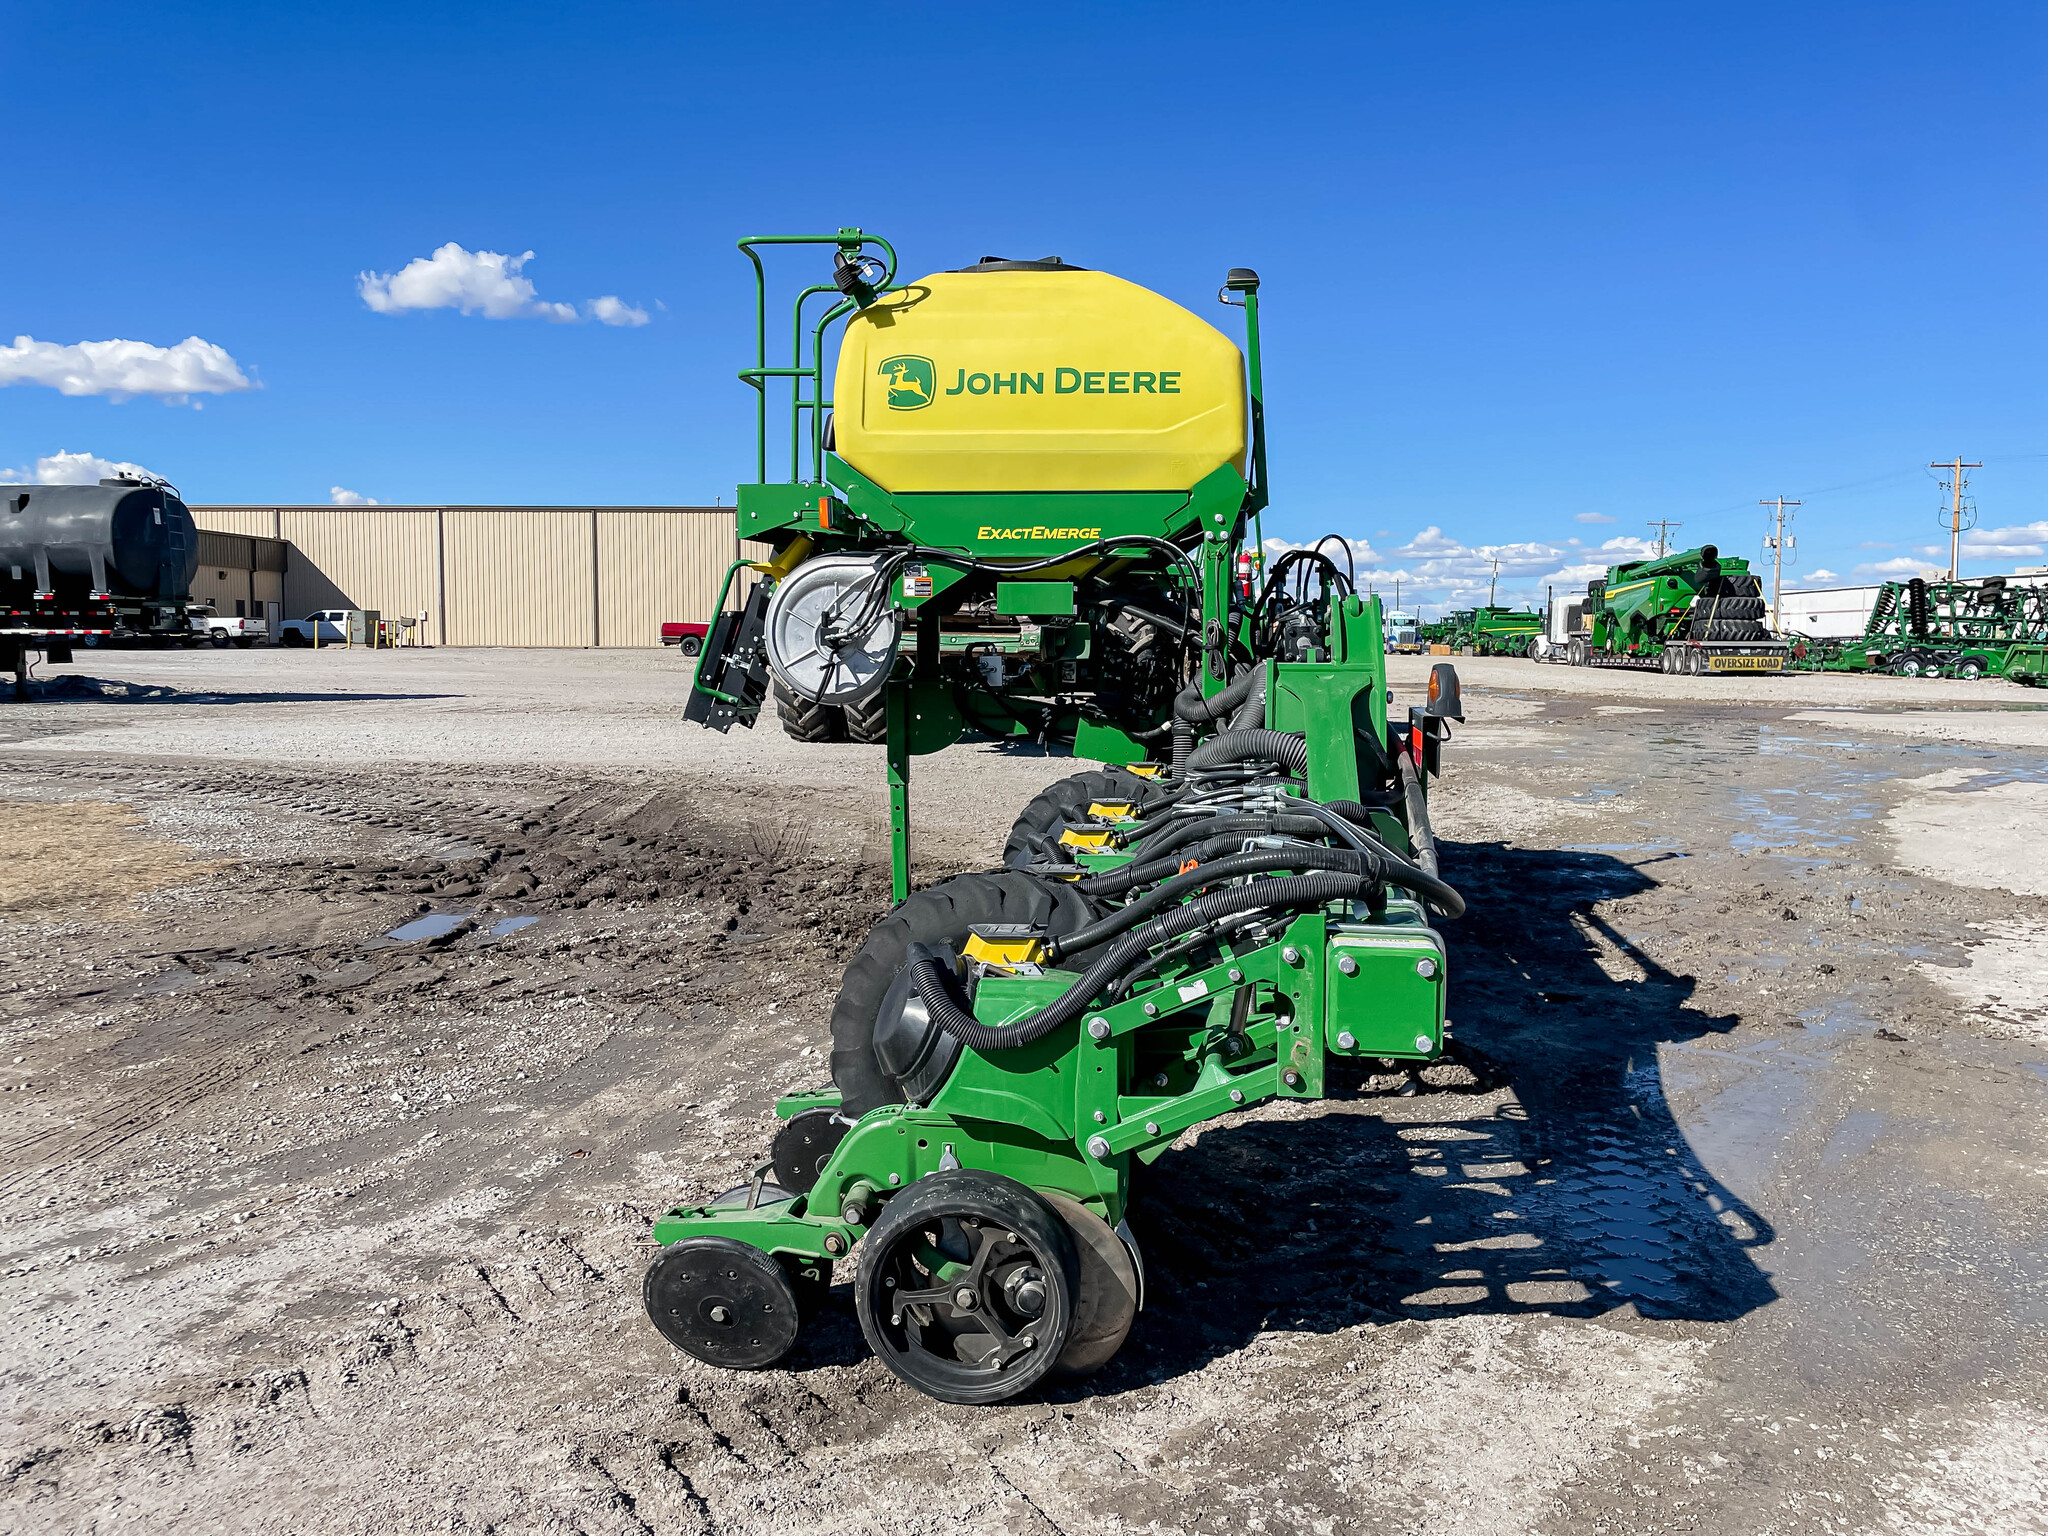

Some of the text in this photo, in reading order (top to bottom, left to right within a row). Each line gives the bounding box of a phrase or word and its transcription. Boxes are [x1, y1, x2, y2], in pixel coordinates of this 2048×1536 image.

[946, 367, 1181, 395] JOHN DEERE
[1714, 658, 1780, 668] OVERSIZE LOAD
